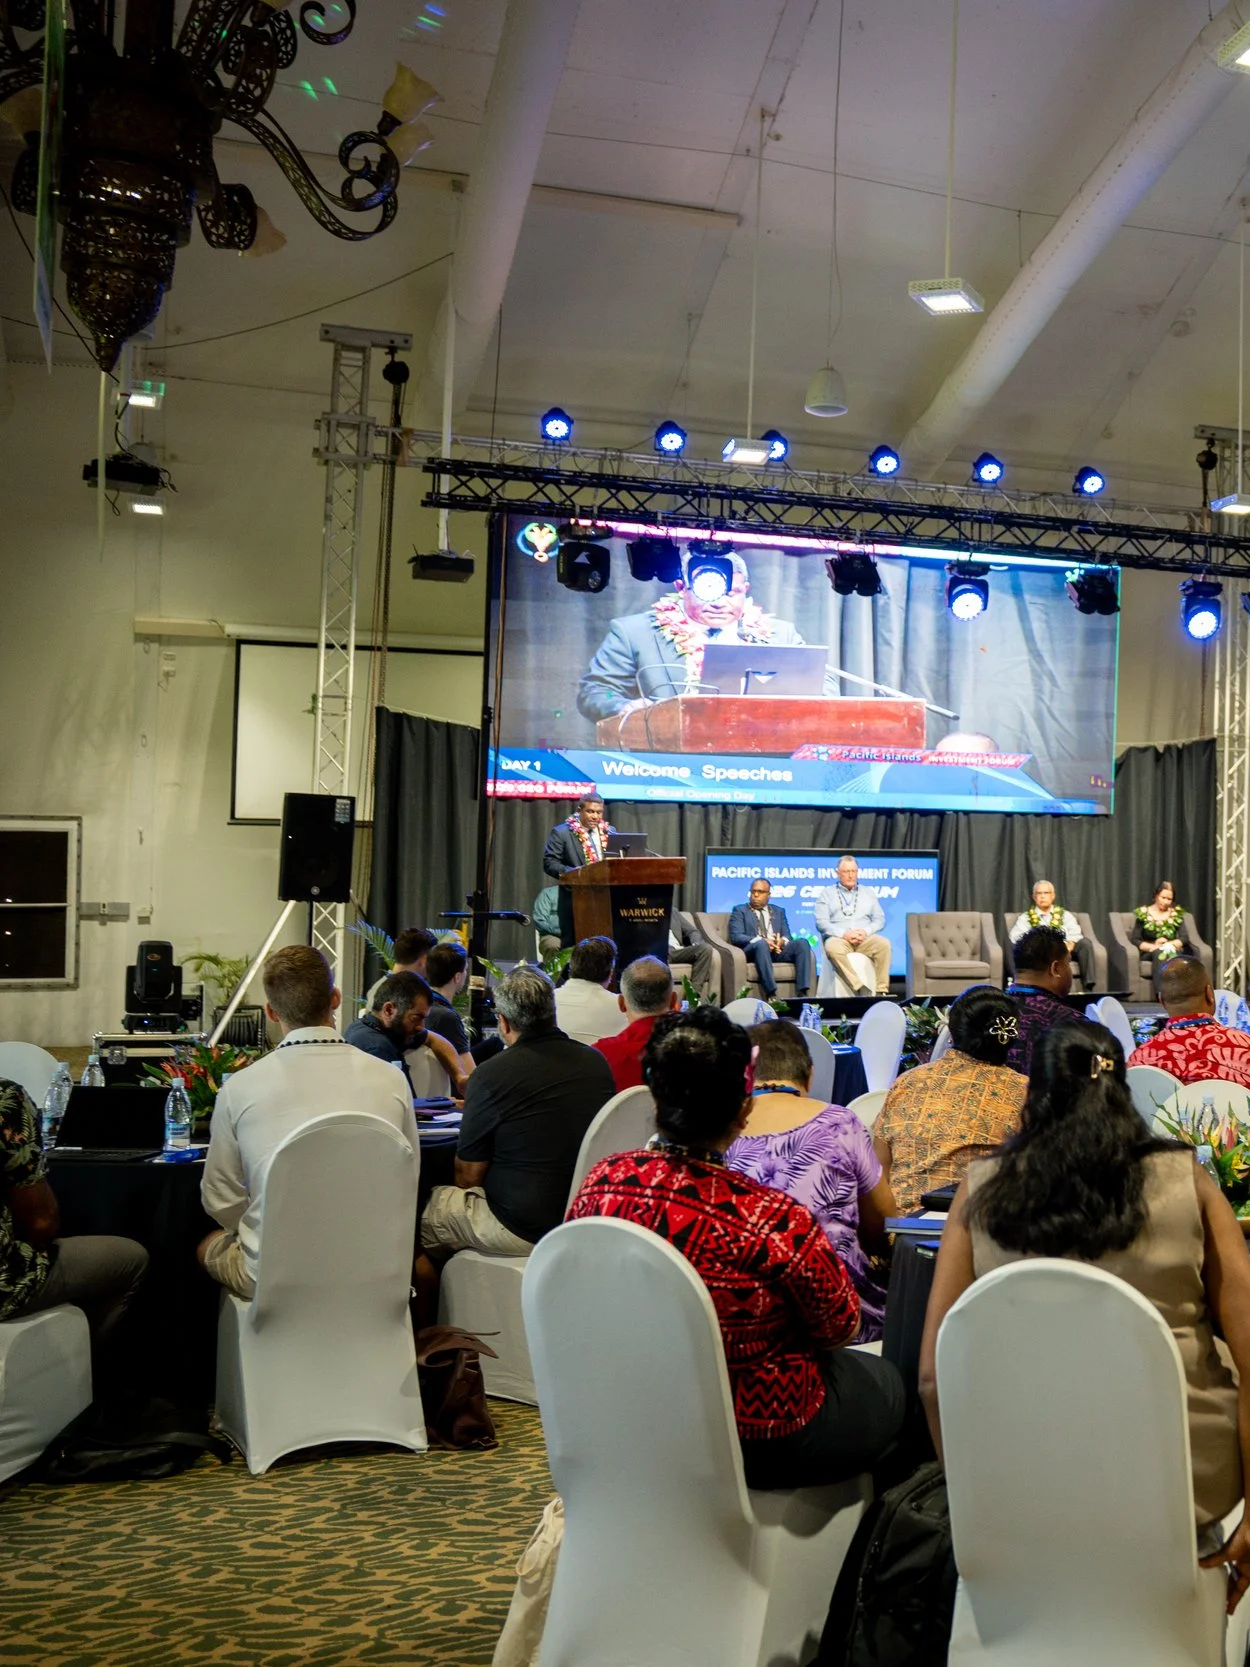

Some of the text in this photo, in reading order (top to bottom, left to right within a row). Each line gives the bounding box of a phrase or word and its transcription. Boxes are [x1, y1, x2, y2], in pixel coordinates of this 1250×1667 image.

[841, 750, 922, 763] Pacific Islands
[501, 760, 541, 771] DAY 1
[601, 761, 793, 782] Welcome Speeches
[646, 788, 756, 801] Official Opening Day
[711, 866, 934, 880] PACIFIC ISLANDS INVMENT FORUM
[619, 908, 665, 917] WARWICK
